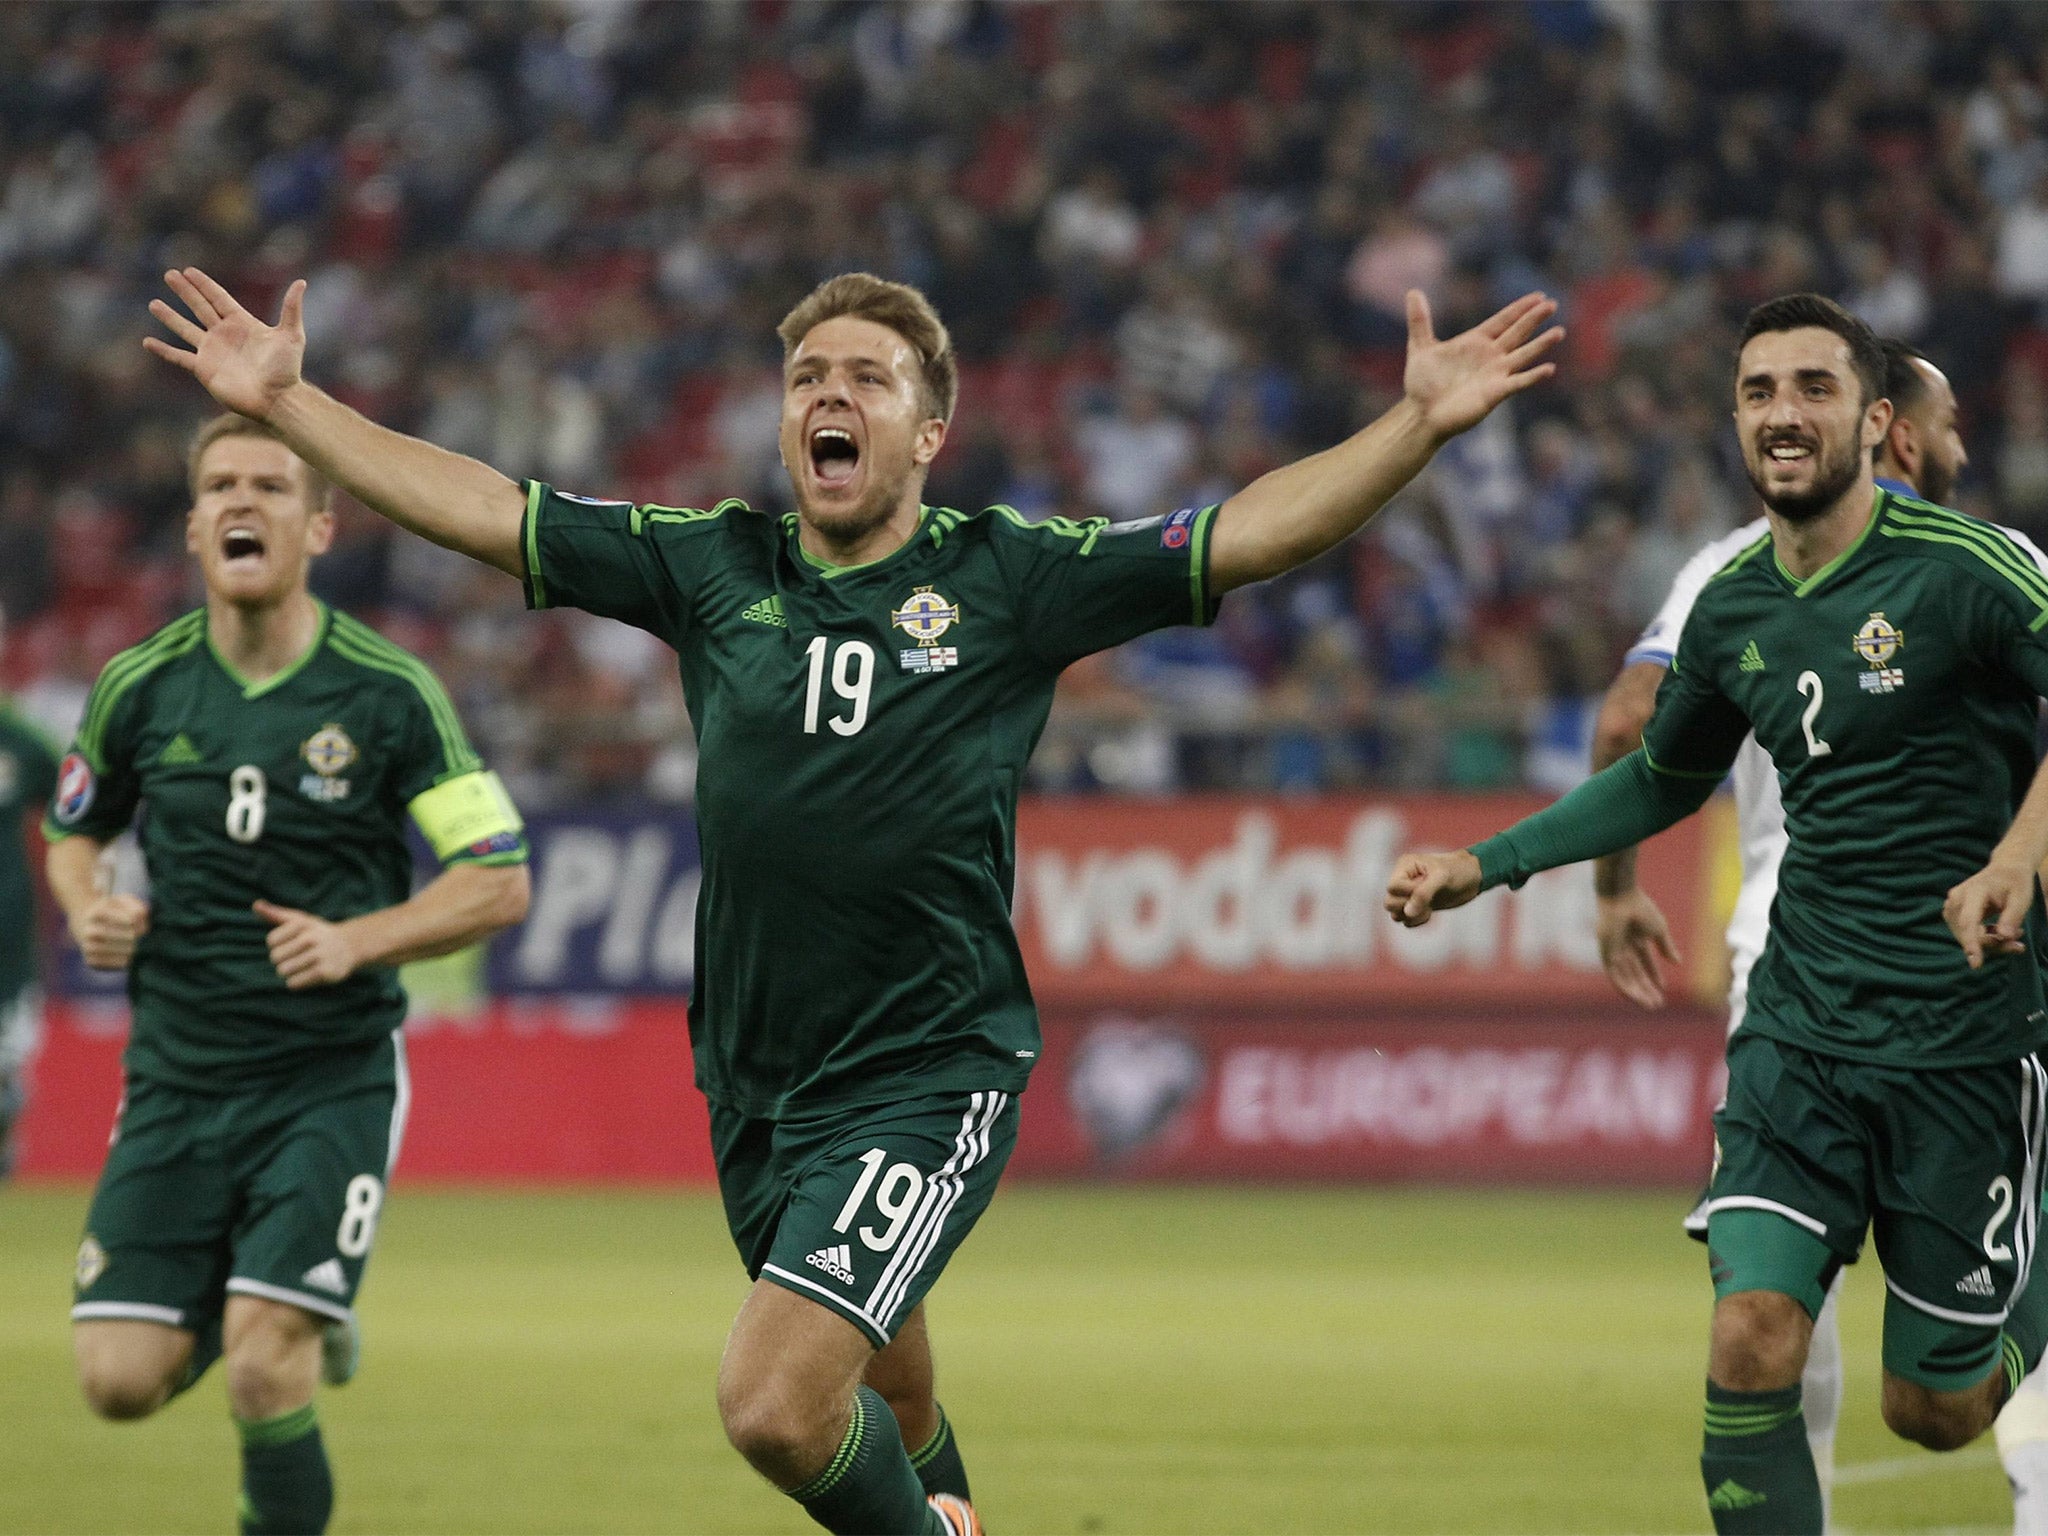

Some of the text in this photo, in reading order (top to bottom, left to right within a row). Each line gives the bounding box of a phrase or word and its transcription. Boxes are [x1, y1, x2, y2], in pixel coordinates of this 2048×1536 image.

[804, 636, 875, 737] 19
[1797, 670, 1832, 757] 2
[226, 765, 266, 843] 8
[1217, 1045, 1696, 1144] EUROPEAN
[337, 1173, 383, 1257] 8
[832, 1147, 924, 1252] 19
[1983, 1174, 2014, 1261] 2
[805, 1252, 856, 1286] adidas
